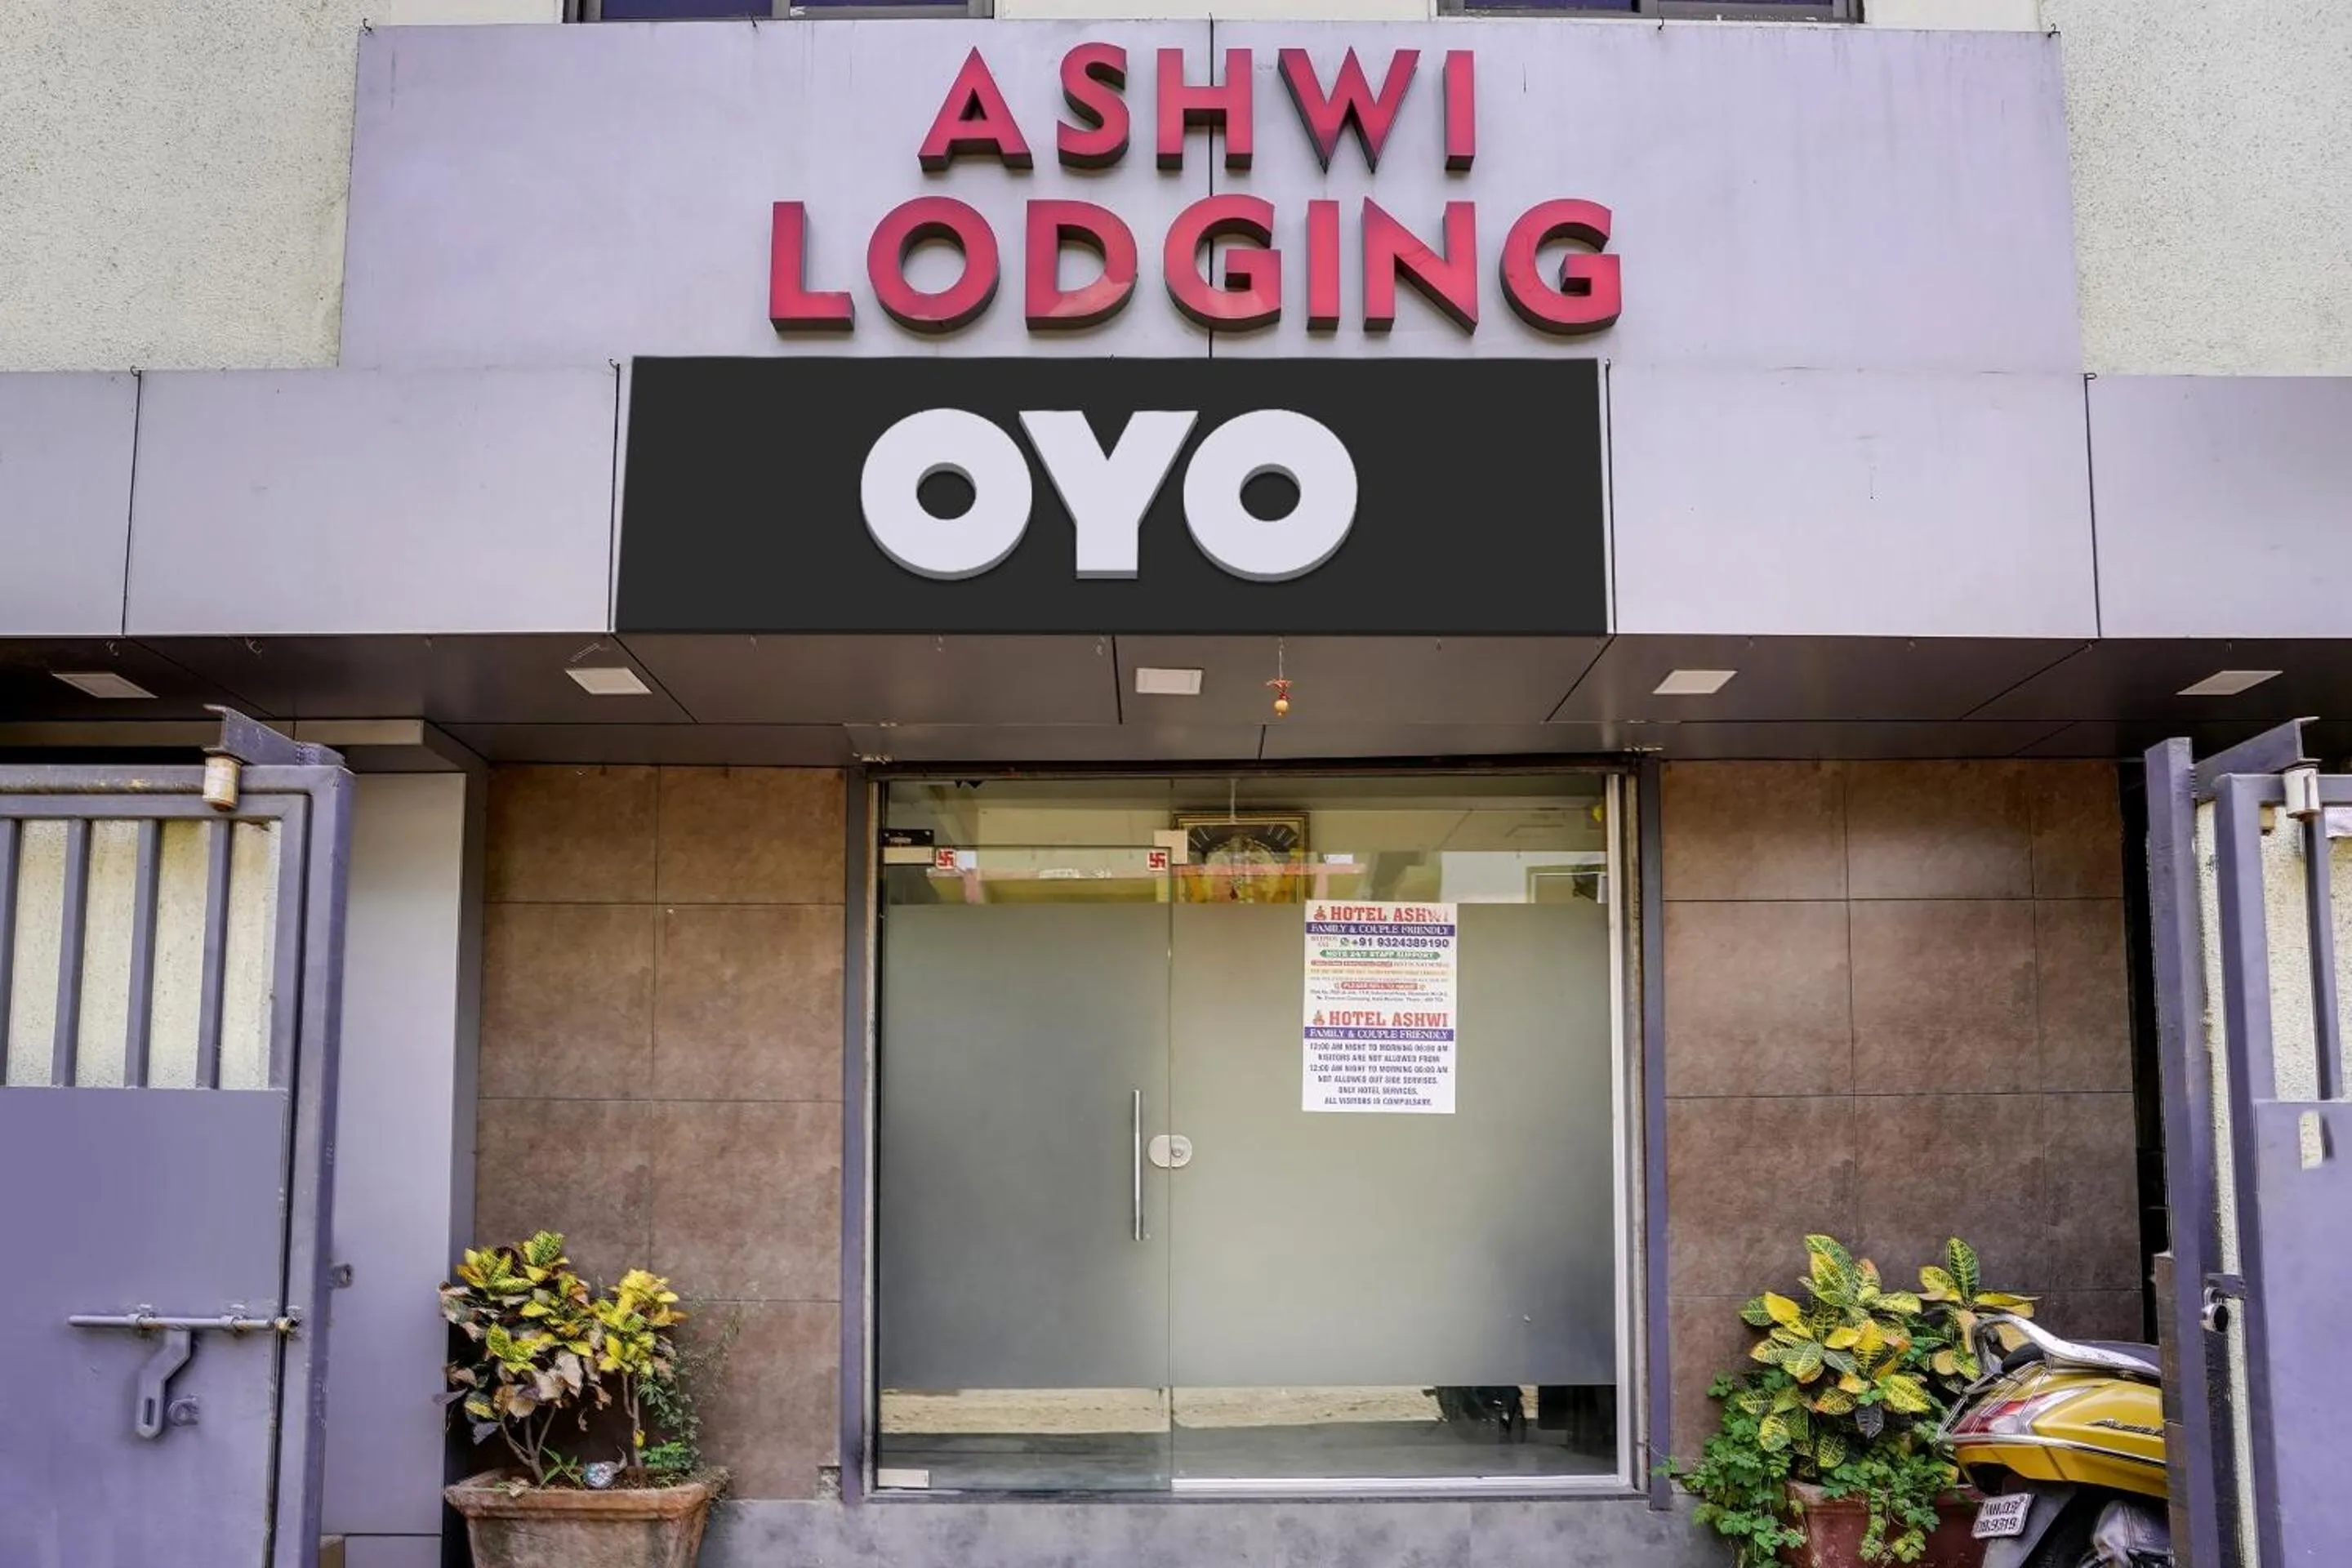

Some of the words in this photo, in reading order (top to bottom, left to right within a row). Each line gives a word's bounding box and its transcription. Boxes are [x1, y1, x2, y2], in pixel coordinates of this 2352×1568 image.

[918, 42, 1477, 172] ASHWI
[768, 194, 1623, 336] LODGING
[860, 408, 1358, 581] OYO
[1330, 906, 1386, 921] HOTEL
[1393, 907, 1448, 922] ASHWI
[1311, 924, 1345, 933] FAMILY
[1349, 924, 1356, 933] &
[1358, 924, 1398, 934] COUPLE
[1401, 925, 1449, 935] FRIENDLY
[1352, 937, 1372, 947] +91
[1377, 937, 1450, 947] 9324389190
[1330, 1011, 1386, 1027] HOTEL
[1392, 1013, 1449, 1027] ASHWI
[1310, 1028, 1343, 1038] FAMILY
[1348, 1029, 1354, 1038] &
[1357, 1029, 1398, 1040] COUPLE
[1400, 1030, 1449, 1040] FRIENDLY
[1379, 1044, 1413, 1052] MORNING
[1352, 1054, 1366, 1062] ARE
[1383, 1054, 1417, 1062] ALLOWED
[1368, 1065, 1377, 1073] TO
[1379, 1065, 1412, 1073] MORNING
[1318, 1075, 1332, 1083] NOT
[1334, 1075, 1366, 1083] ALLOWED
[1368, 1075, 1383, 1083] OUT
[1324, 1097, 1338, 1105] ALL
